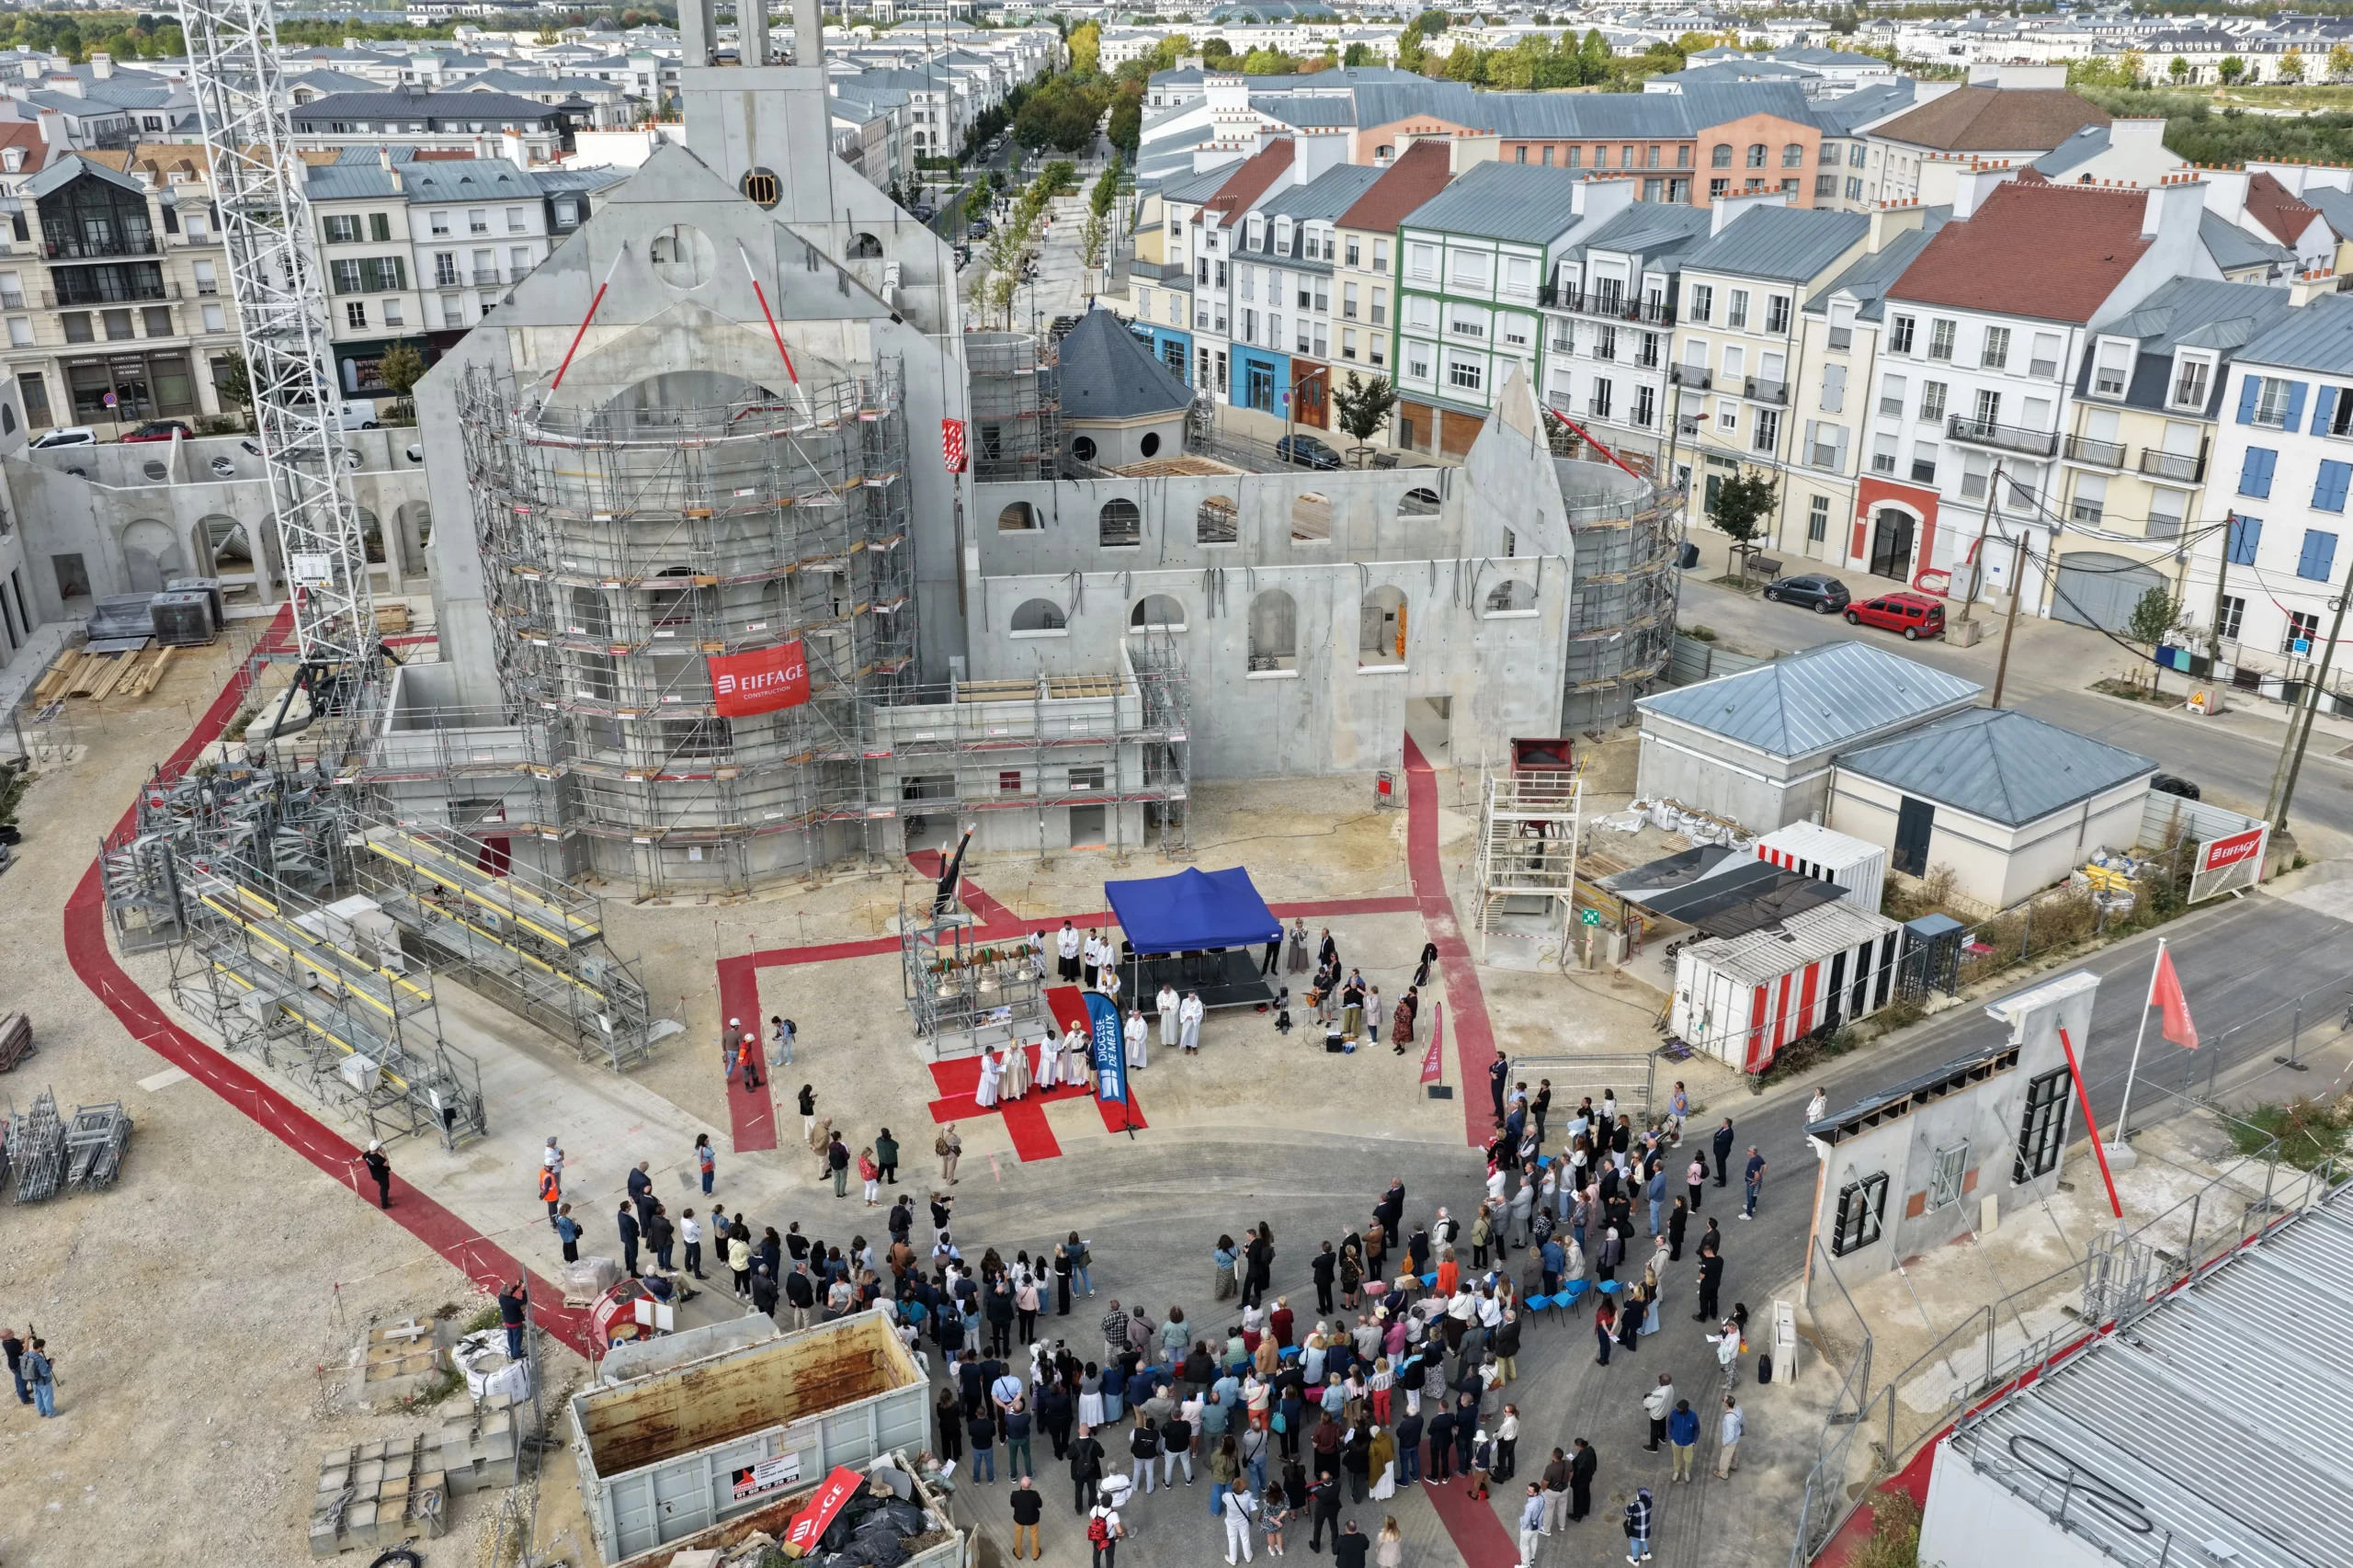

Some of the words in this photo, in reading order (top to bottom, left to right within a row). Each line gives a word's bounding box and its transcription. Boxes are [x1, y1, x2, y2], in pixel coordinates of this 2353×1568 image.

[741, 664, 804, 691] EIFFAGE
[743, 685, 791, 700] CONSTRUCTION
[1105, 1013, 1117, 1052] MEAUX
[1108, 1054, 1118, 1067] DE
